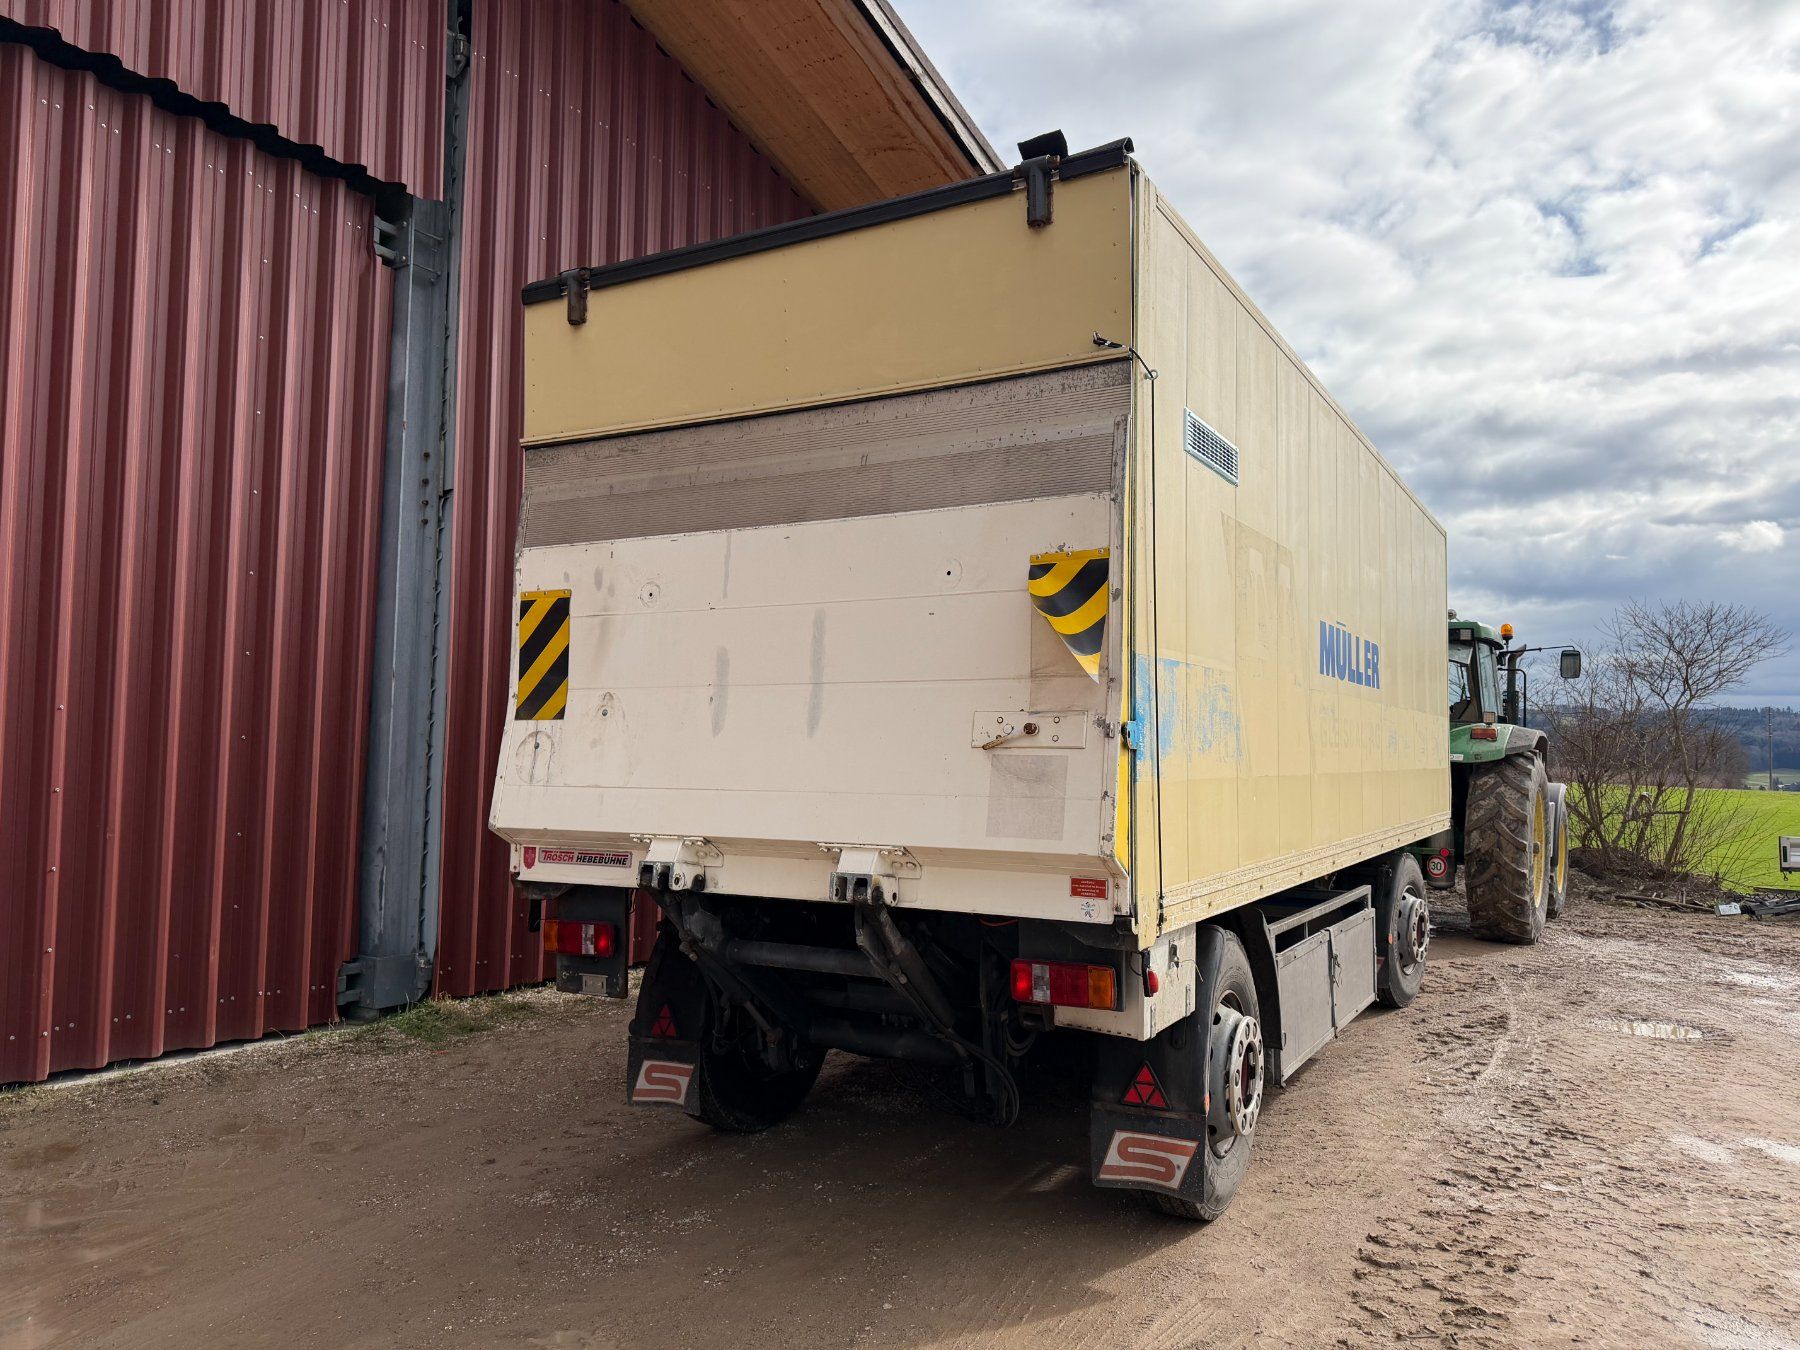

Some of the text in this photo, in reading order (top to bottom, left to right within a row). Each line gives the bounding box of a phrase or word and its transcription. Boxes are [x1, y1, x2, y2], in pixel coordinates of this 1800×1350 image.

[1319, 619, 1380, 690] MÜLLER
[575, 851, 629, 866] HEBEBÜHNE
[1430, 861, 1442, 871] 30
